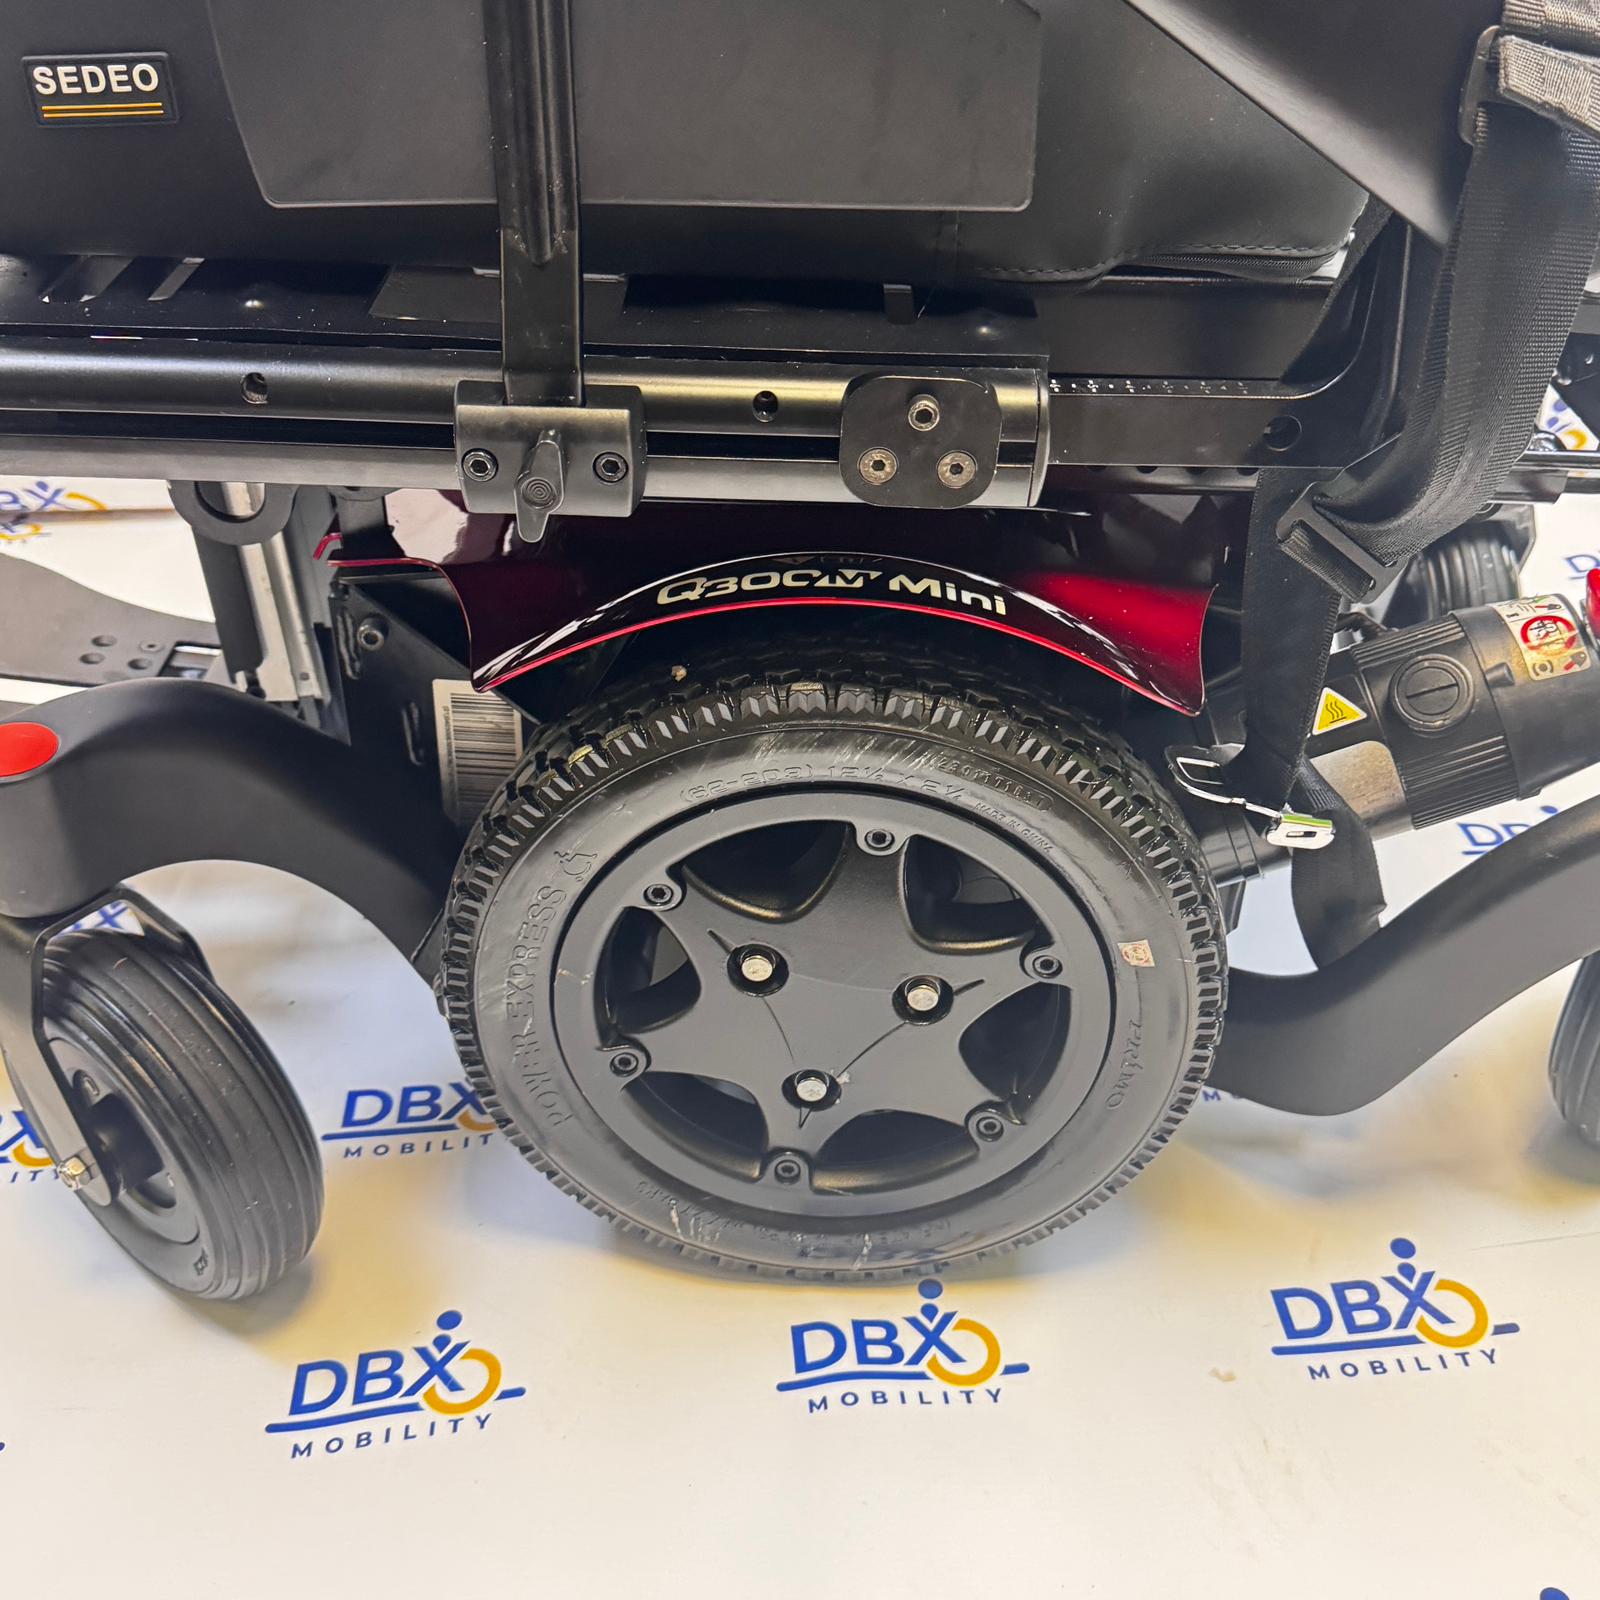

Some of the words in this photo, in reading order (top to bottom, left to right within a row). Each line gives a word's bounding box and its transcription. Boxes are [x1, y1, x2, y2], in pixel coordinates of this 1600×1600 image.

[32, 63, 159, 95] SEDEO
[888, 573, 1007, 616] Mini
[505, 884, 568, 1019] EXPRESS
[341, 1081, 490, 1129] DBX
[343, 1131, 494, 1159] MOBILIT
[1270, 1270, 1457, 1341] DBX
[790, 1310, 968, 1375] DBX
[1307, 1348, 1497, 1381] MOBILITY
[288, 1340, 472, 1417] DBX
[807, 1387, 1002, 1414] MOBILITY
[290, 1412, 492, 1460] MOBILITY
